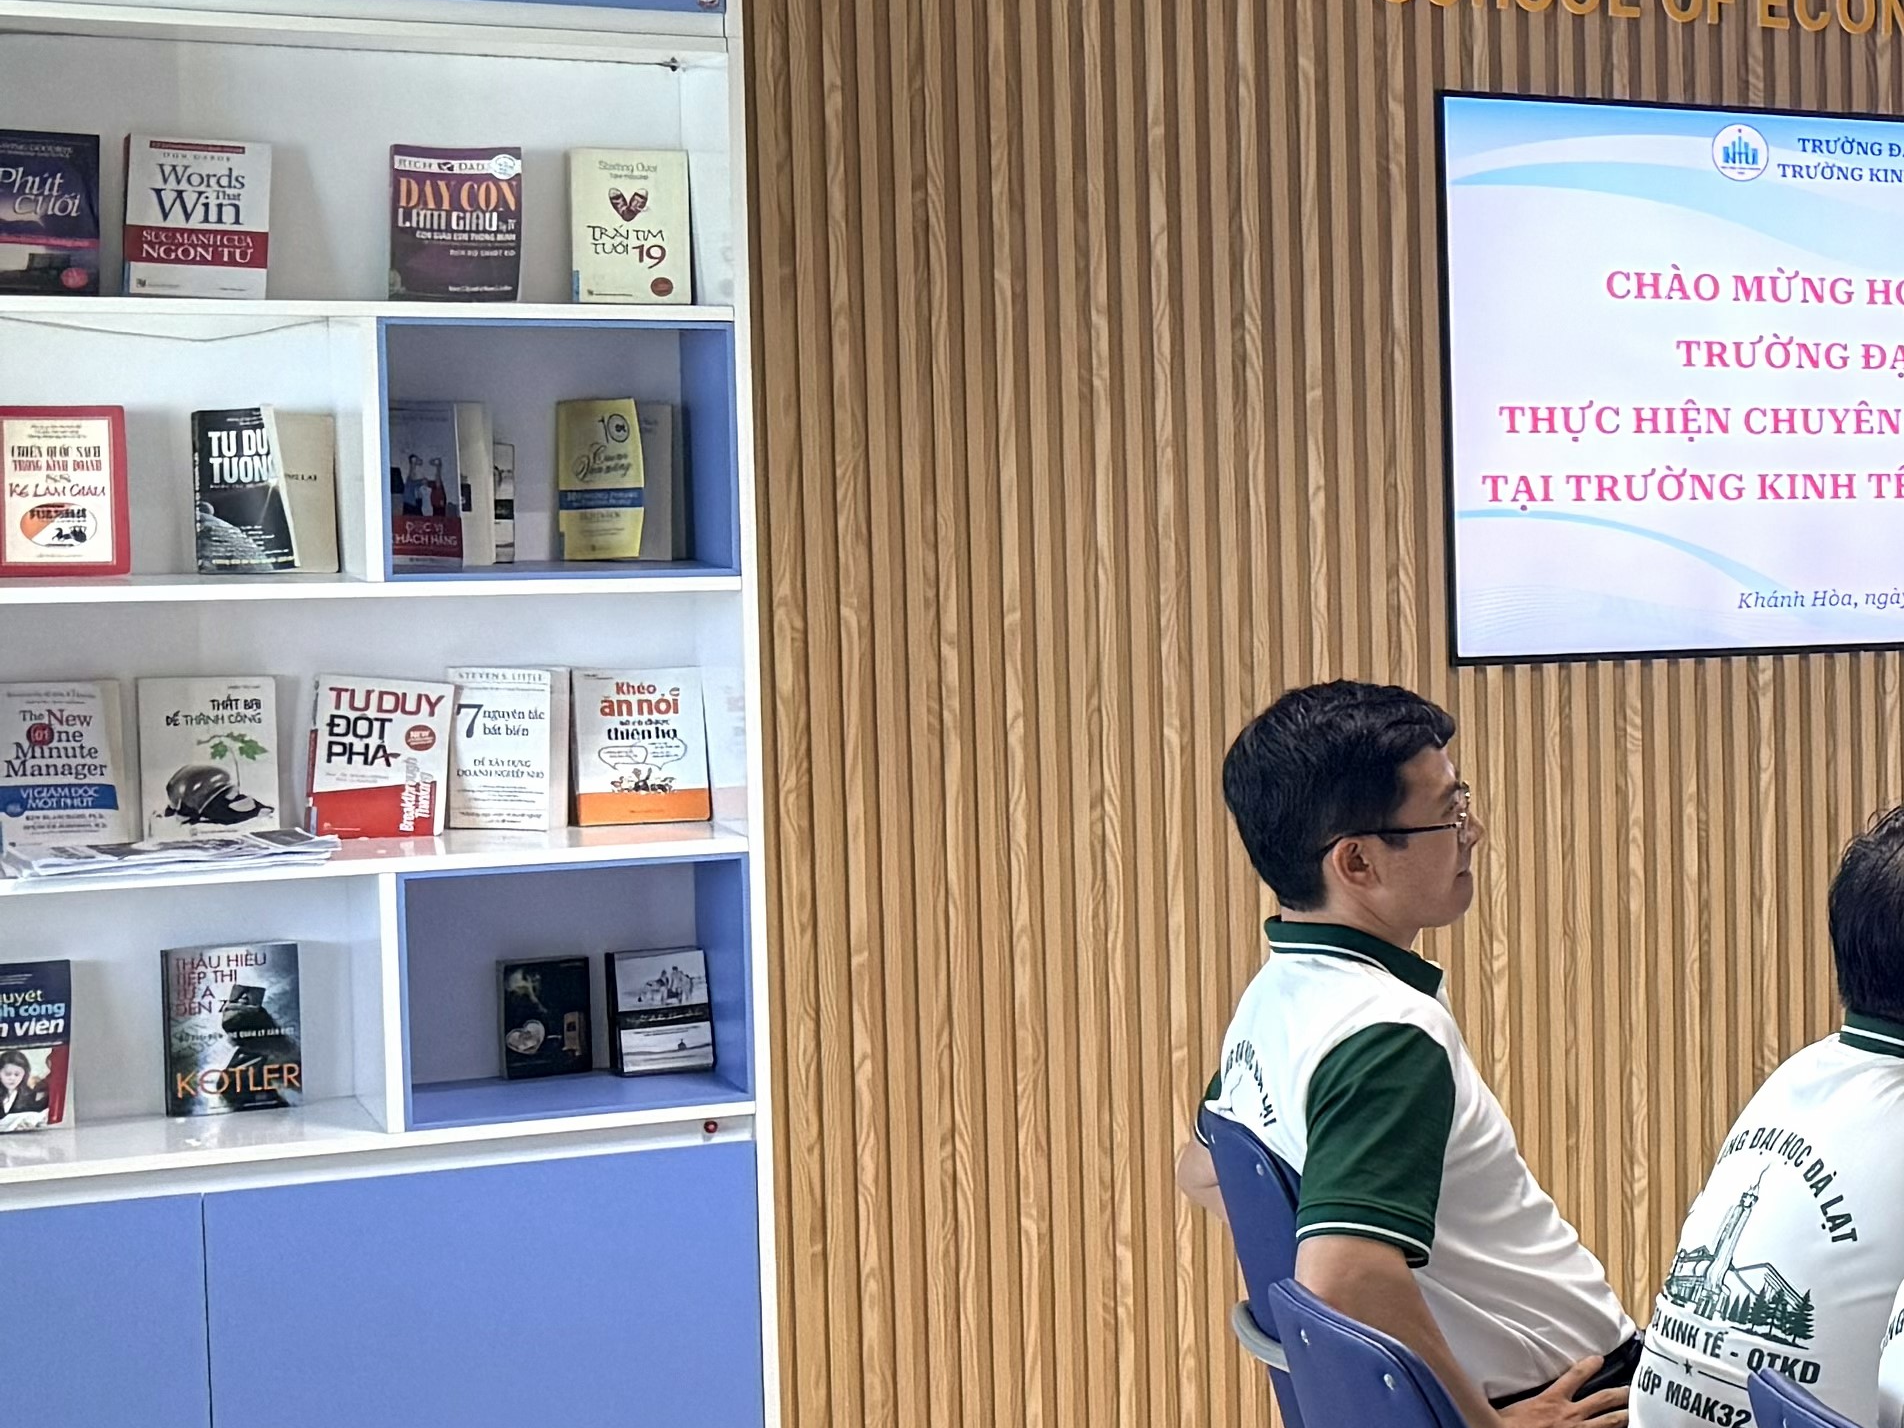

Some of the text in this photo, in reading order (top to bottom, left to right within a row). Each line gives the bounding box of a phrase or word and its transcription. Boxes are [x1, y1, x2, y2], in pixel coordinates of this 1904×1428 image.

[1797, 135, 1883, 157] TRƯỜNG
[157, 163, 245, 190] Words
[1777, 160, 1864, 182] TRƯỜNG
[150, 187, 244, 226] Win
[460, 180, 517, 211] CON
[632, 244, 667, 270] 19
[1605, 263, 1721, 301] CHÀO
[1732, 266, 1855, 305] MỪNG
[1676, 333, 1851, 370] TRƯỜNG
[1499, 399, 1620, 443] THỰC
[1632, 398, 1731, 442] HIỆN
[1743, 400, 1901, 436] CHUYÊN
[1481, 474, 1554, 512] TẠI
[1566, 465, 1746, 502] TRƯỜNG
[1756, 473, 1857, 501] KINH
[1738, 589, 1806, 610] Khánh
[1811, 590, 1859, 611] Hòa,
[46, 709, 93, 727] New
[376, 690, 446, 718] DUY
[326, 713, 393, 742] ĐỘT
[455, 703, 484, 739] 7
[14, 742, 99, 760] Minute
[4, 759, 107, 781] Manager
[176, 1063, 301, 1099] KOTLER
[1749, 1127, 1858, 1243] ĐẠI HỌC ĐÀ LẠT
[1660, 1314, 1700, 1349] KINH
[1702, 1331, 1729, 1360] TẾ
